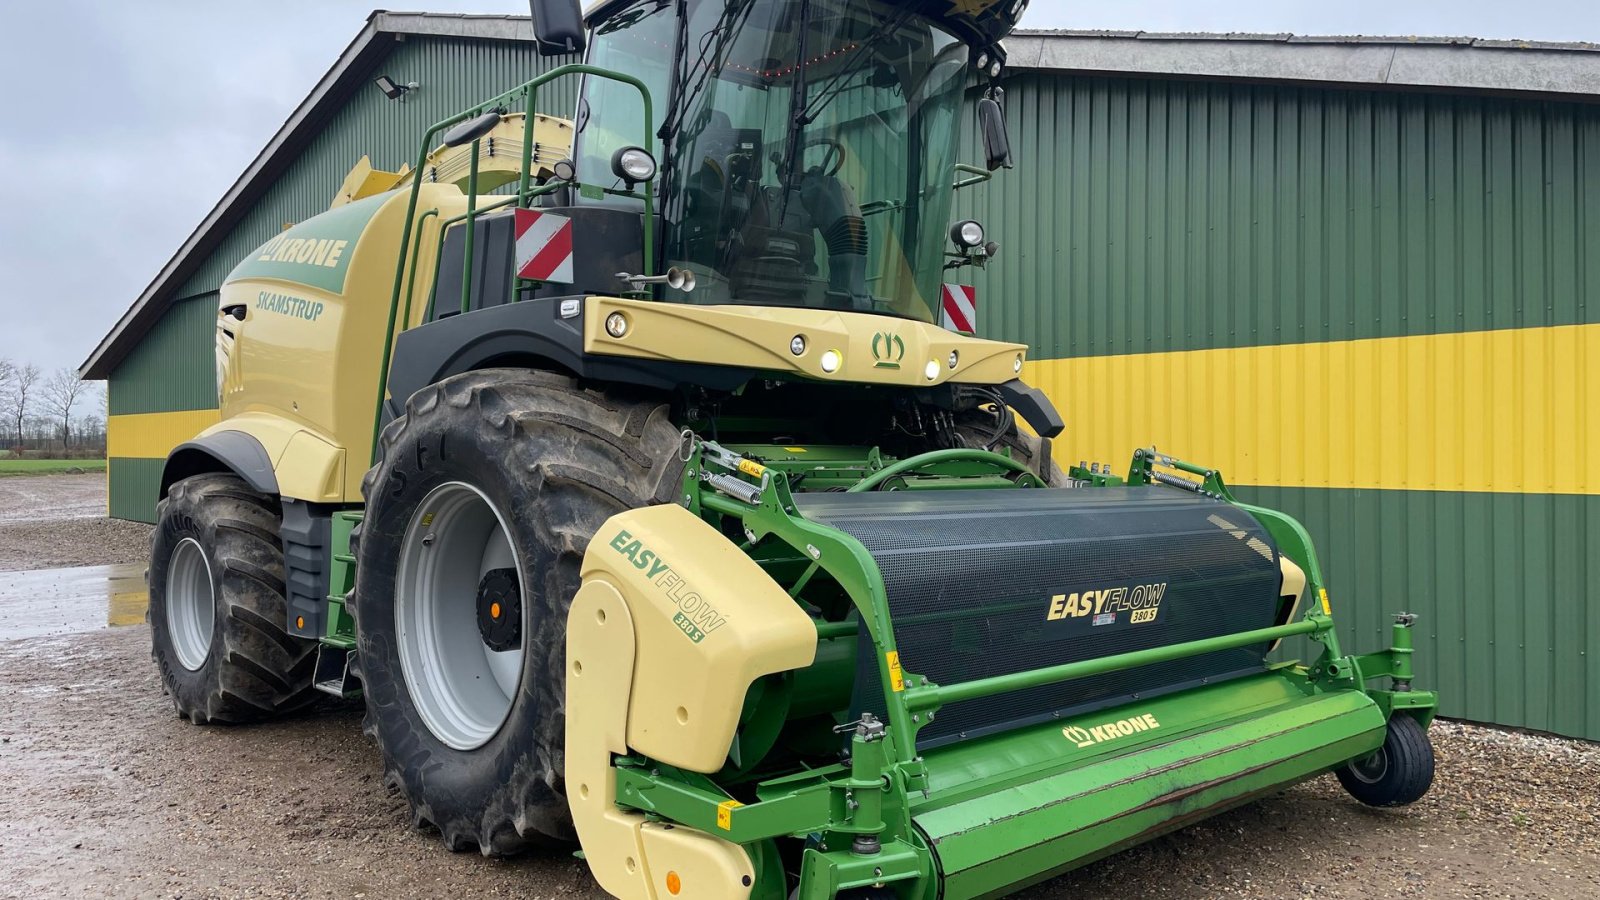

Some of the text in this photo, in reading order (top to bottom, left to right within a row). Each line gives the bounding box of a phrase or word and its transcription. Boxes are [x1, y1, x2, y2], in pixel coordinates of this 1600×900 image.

[272, 239, 348, 268] KRONE
[256, 291, 324, 321] SKAMSTRUP
[675, 614, 702, 641] 380 S
[1133, 609, 1155, 622] 380 S
[1088, 713, 1160, 743] KRONE
